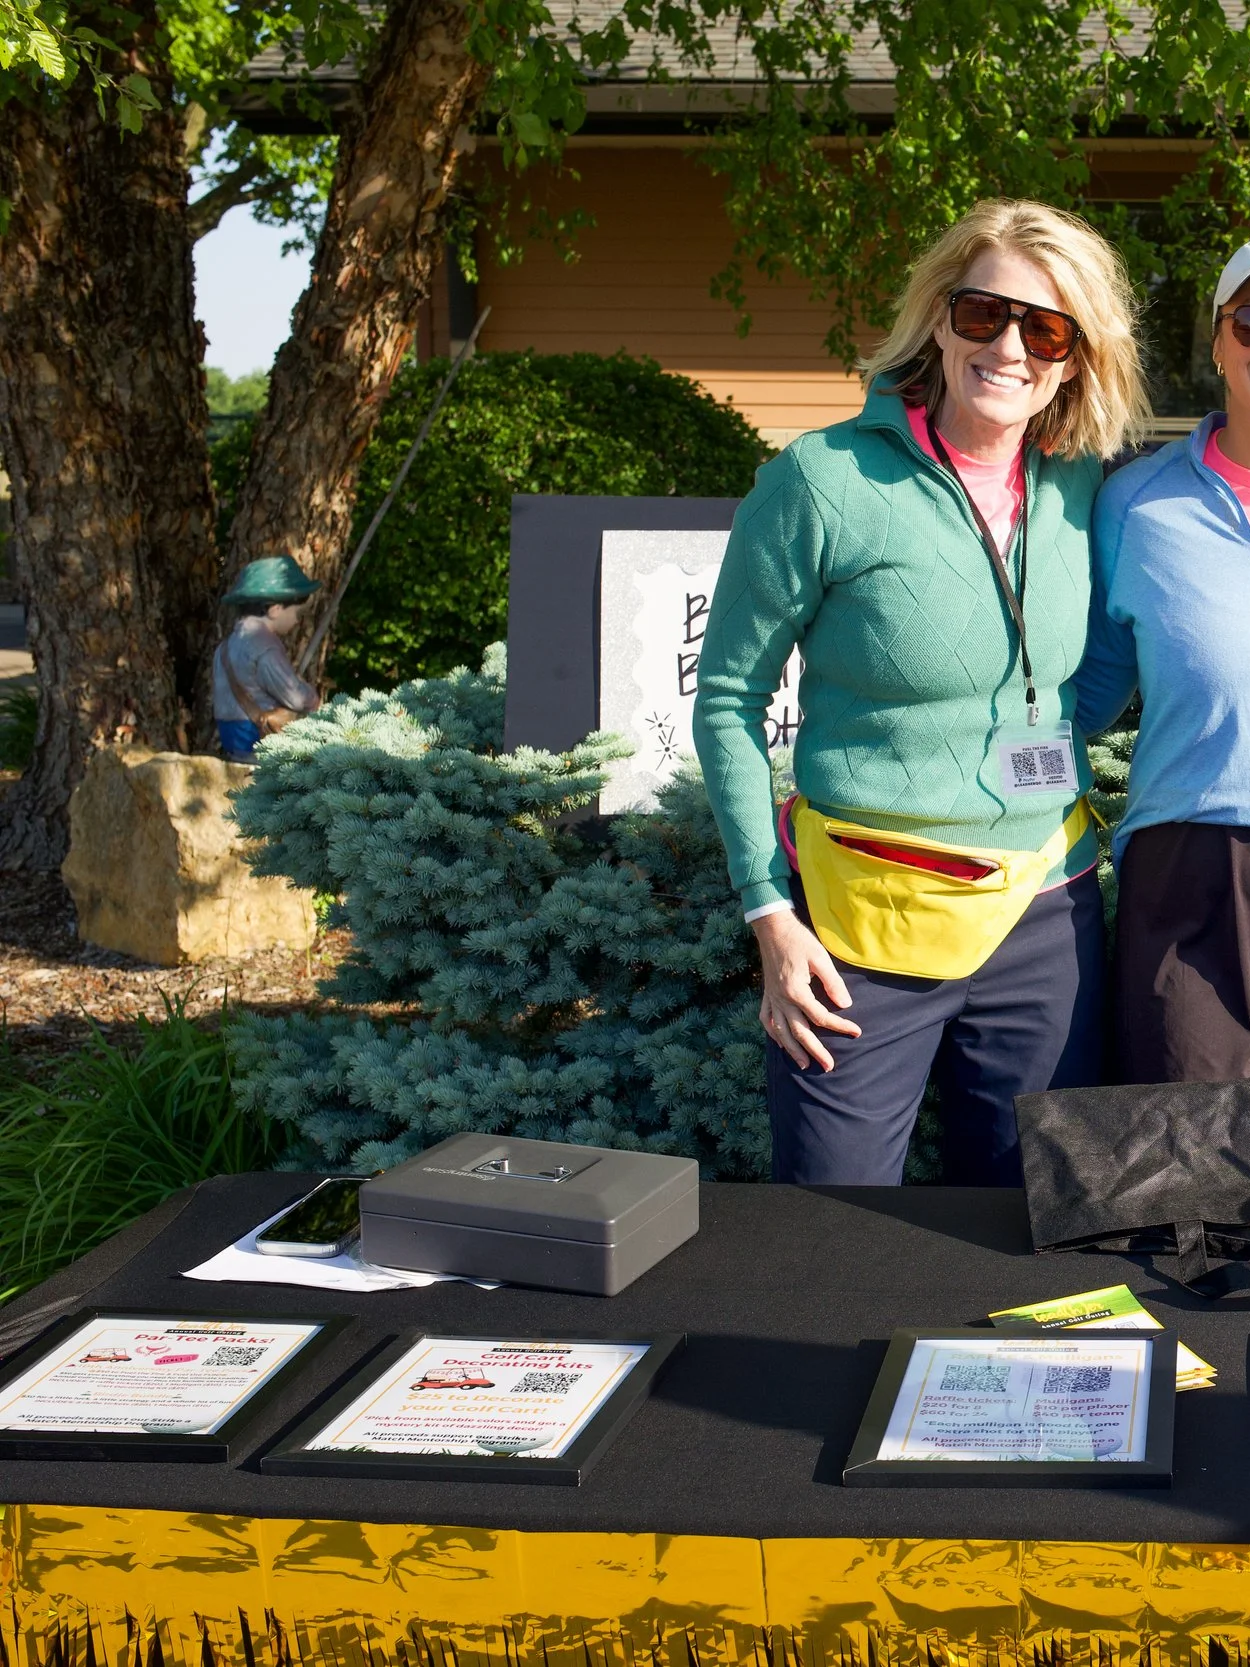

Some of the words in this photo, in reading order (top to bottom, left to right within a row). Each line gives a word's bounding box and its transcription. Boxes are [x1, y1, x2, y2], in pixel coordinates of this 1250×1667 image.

[1041, 1320, 1067, 1329] Annual
[1085, 1311, 1110, 1320] Outing
[134, 1333, 209, 1342] Par-Tee
[212, 1336, 276, 1344] Packs!
[443, 1359, 551, 1369] Decorating
[406, 1393, 442, 1401] $25
[473, 1394, 564, 1404] Decorate
[399, 1404, 447, 1412] your
[452, 1404, 496, 1412] Golf
[499, 1405, 548, 1414] Cart!
[1087, 1403, 1130, 1411] player
